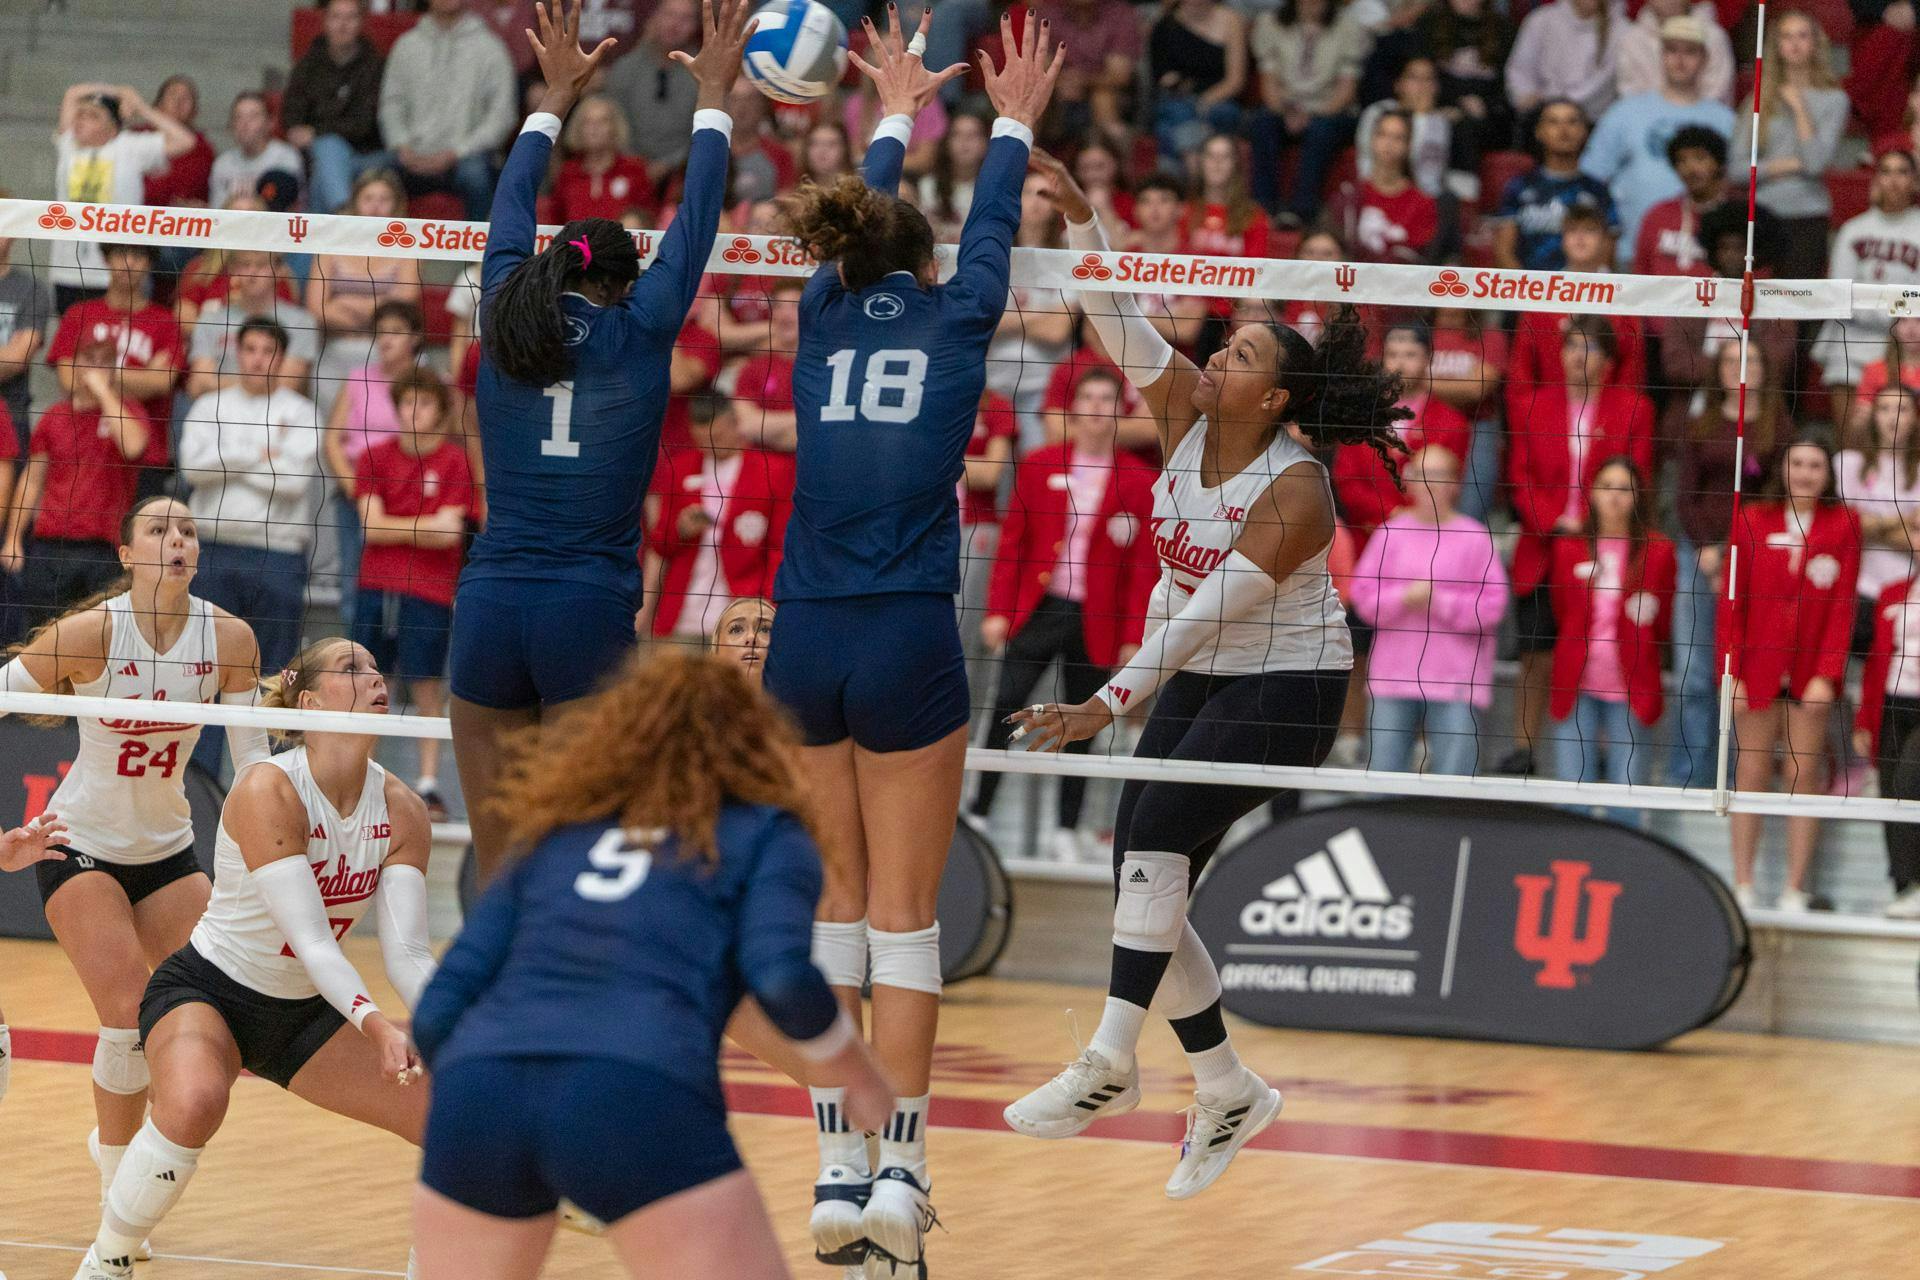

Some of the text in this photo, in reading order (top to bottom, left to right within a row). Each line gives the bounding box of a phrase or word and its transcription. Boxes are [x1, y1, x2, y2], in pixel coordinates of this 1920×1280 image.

[819, 348, 930, 425] 18
[540, 380, 581, 458] 1
[116, 739, 181, 779] 24
[573, 827, 667, 903] 5
[1239, 896, 1414, 941] adidas
[1220, 961, 1417, 997] OFFICIAL OUTFITTER
